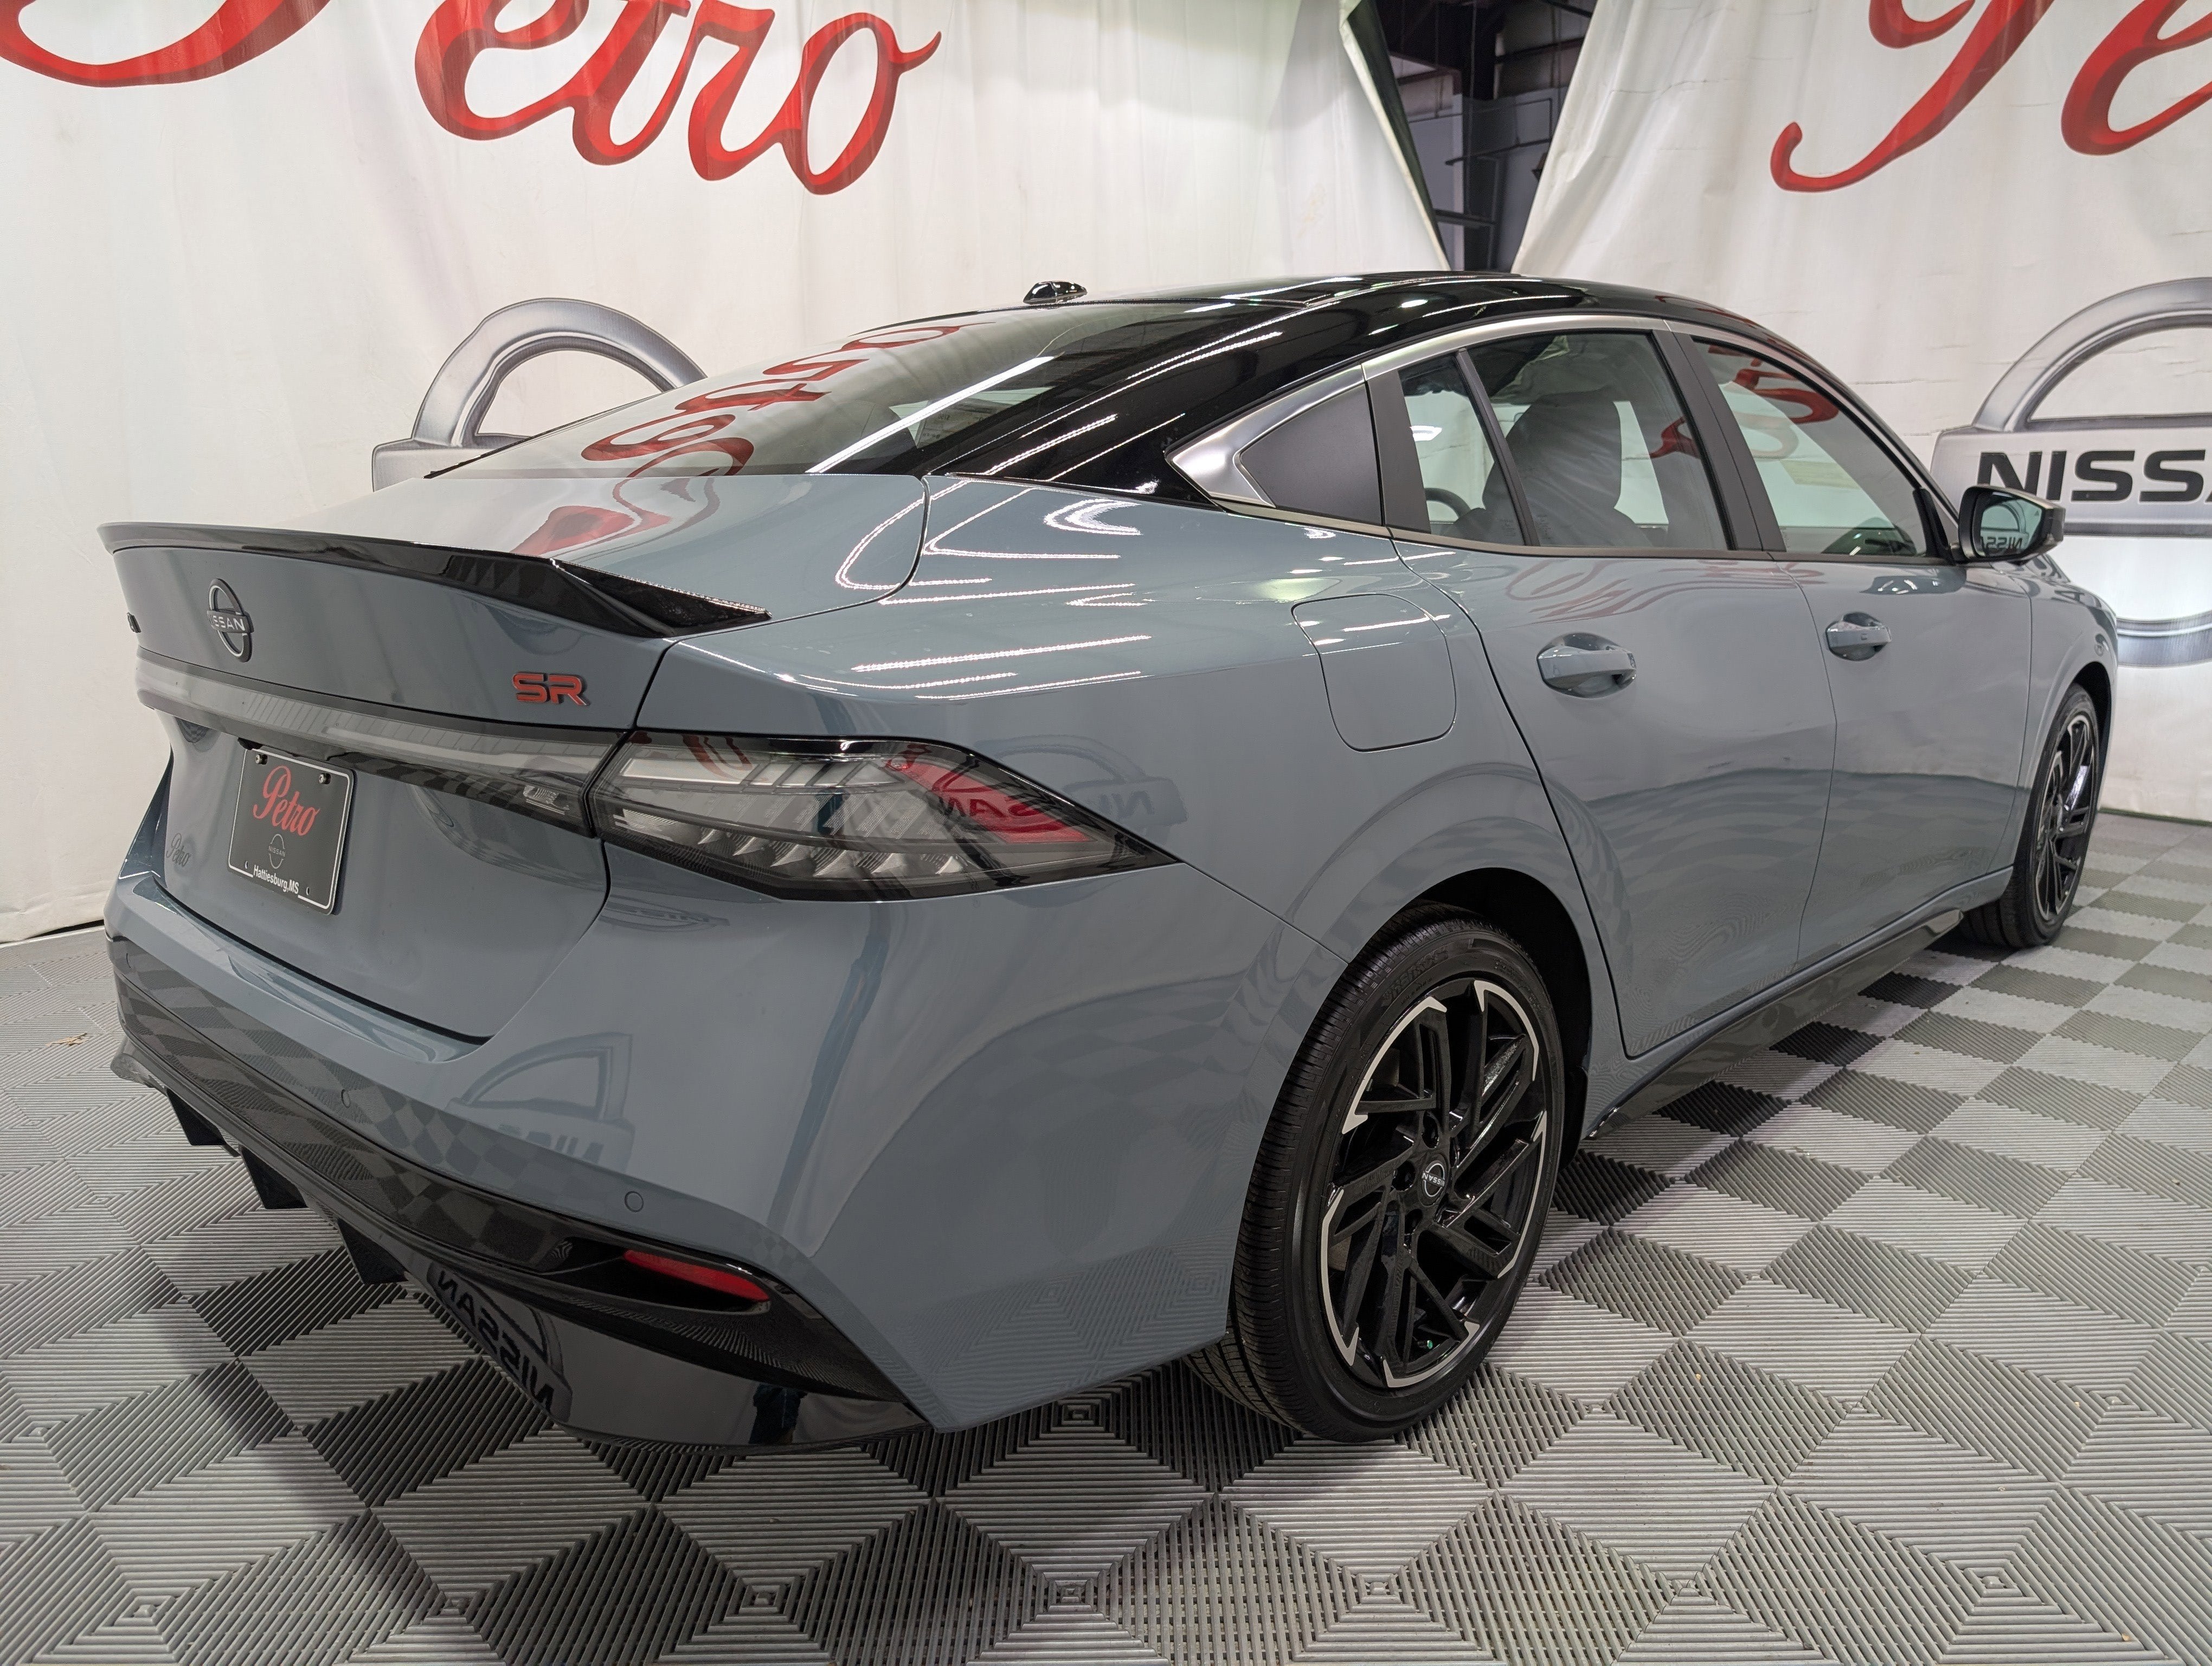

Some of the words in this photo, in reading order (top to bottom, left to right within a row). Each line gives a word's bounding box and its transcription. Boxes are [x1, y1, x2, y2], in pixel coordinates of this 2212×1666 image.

[0, 0, 941, 195] etro
[1977, 450, 2212, 502] NISS
[209, 614, 245, 631] SSAN
[512, 672, 587, 706] SR
[253, 765, 321, 836] Petro
[166, 832, 192, 867] Petro
[268, 845, 286, 857] NISSAN
[1422, 1172, 1445, 1187] NISSAN
